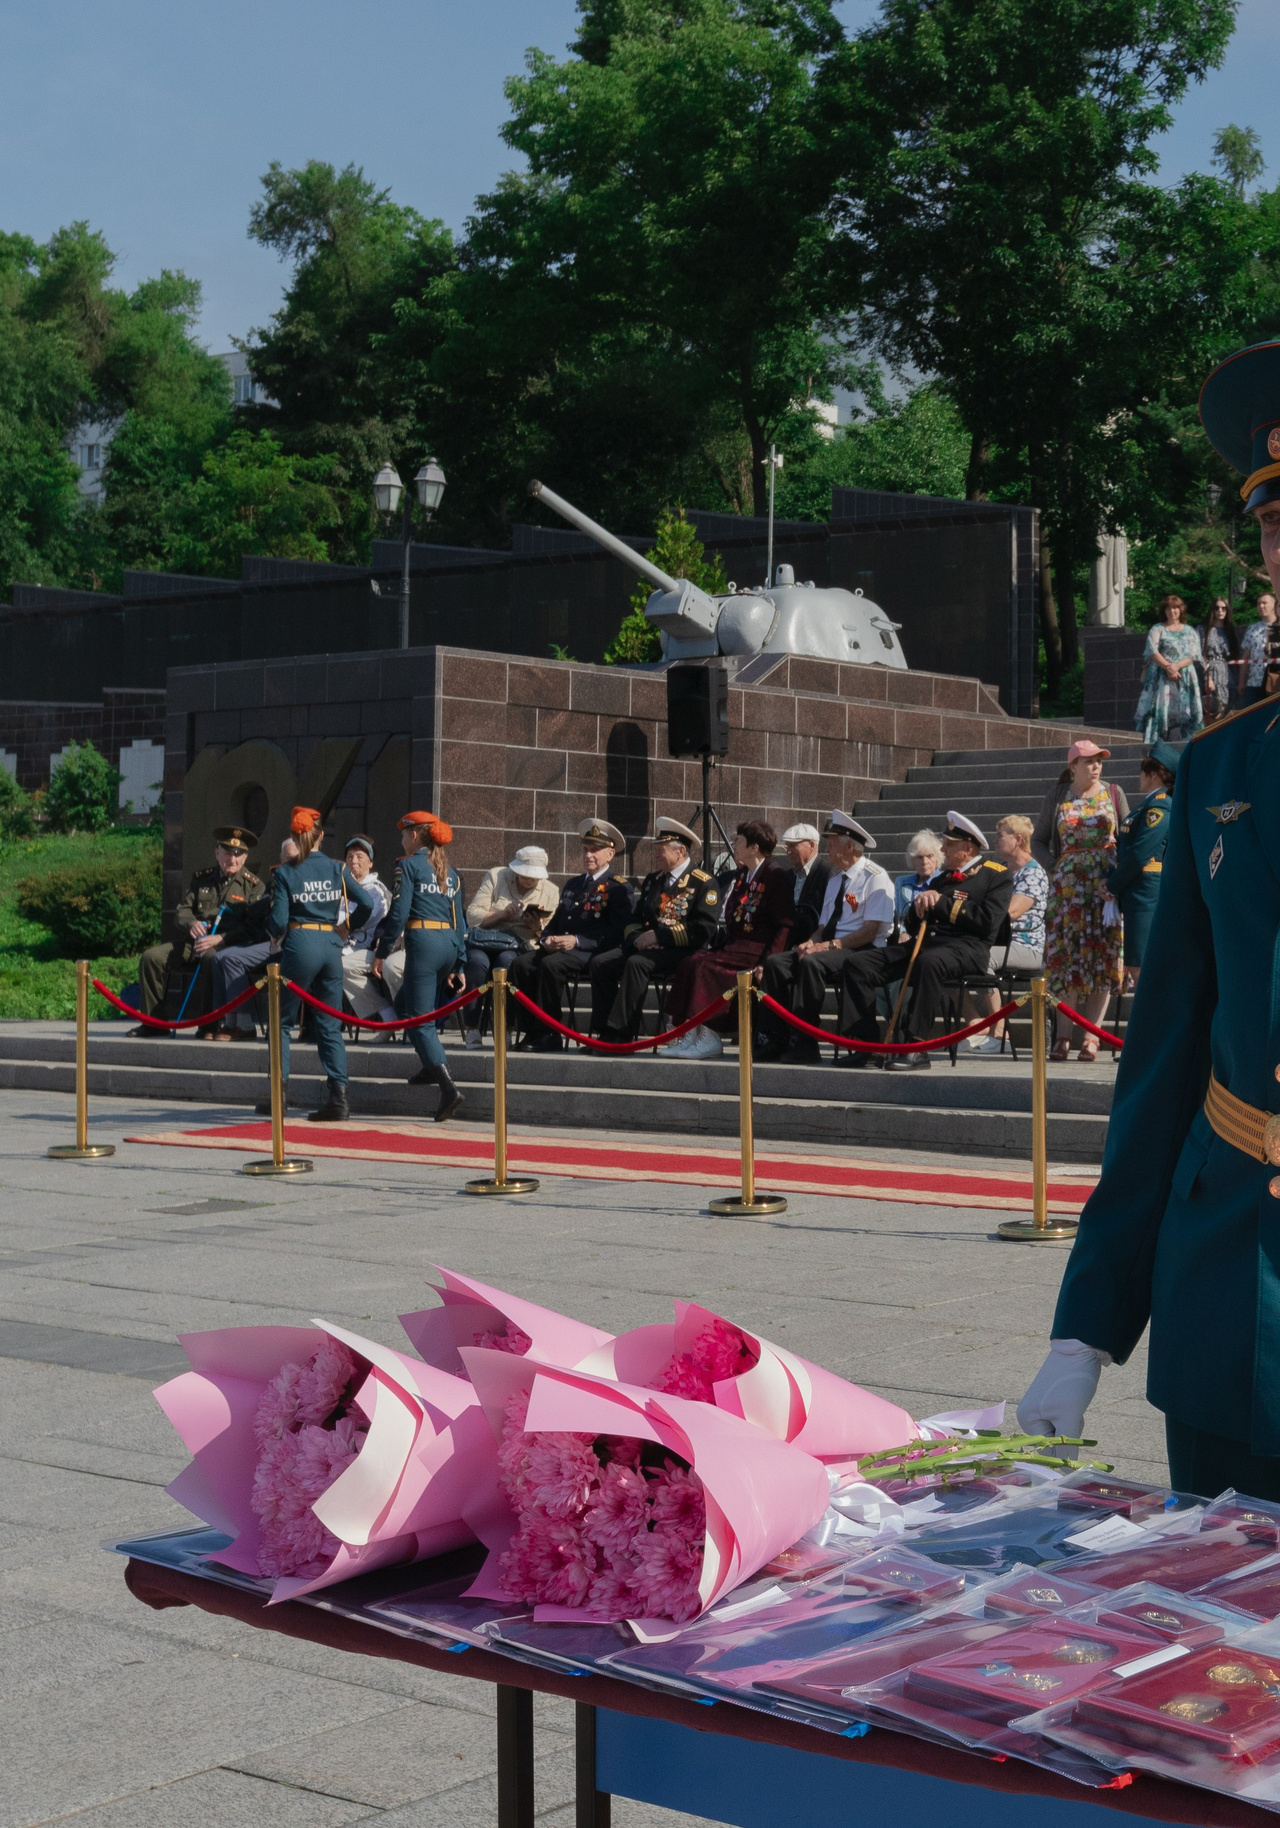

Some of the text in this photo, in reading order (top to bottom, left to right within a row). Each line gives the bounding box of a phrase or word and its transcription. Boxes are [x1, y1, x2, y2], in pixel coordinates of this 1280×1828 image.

[303, 880, 332, 892] МЧС
[431, 873, 453, 887] МС
[292, 889, 342, 903] РОССИИ
